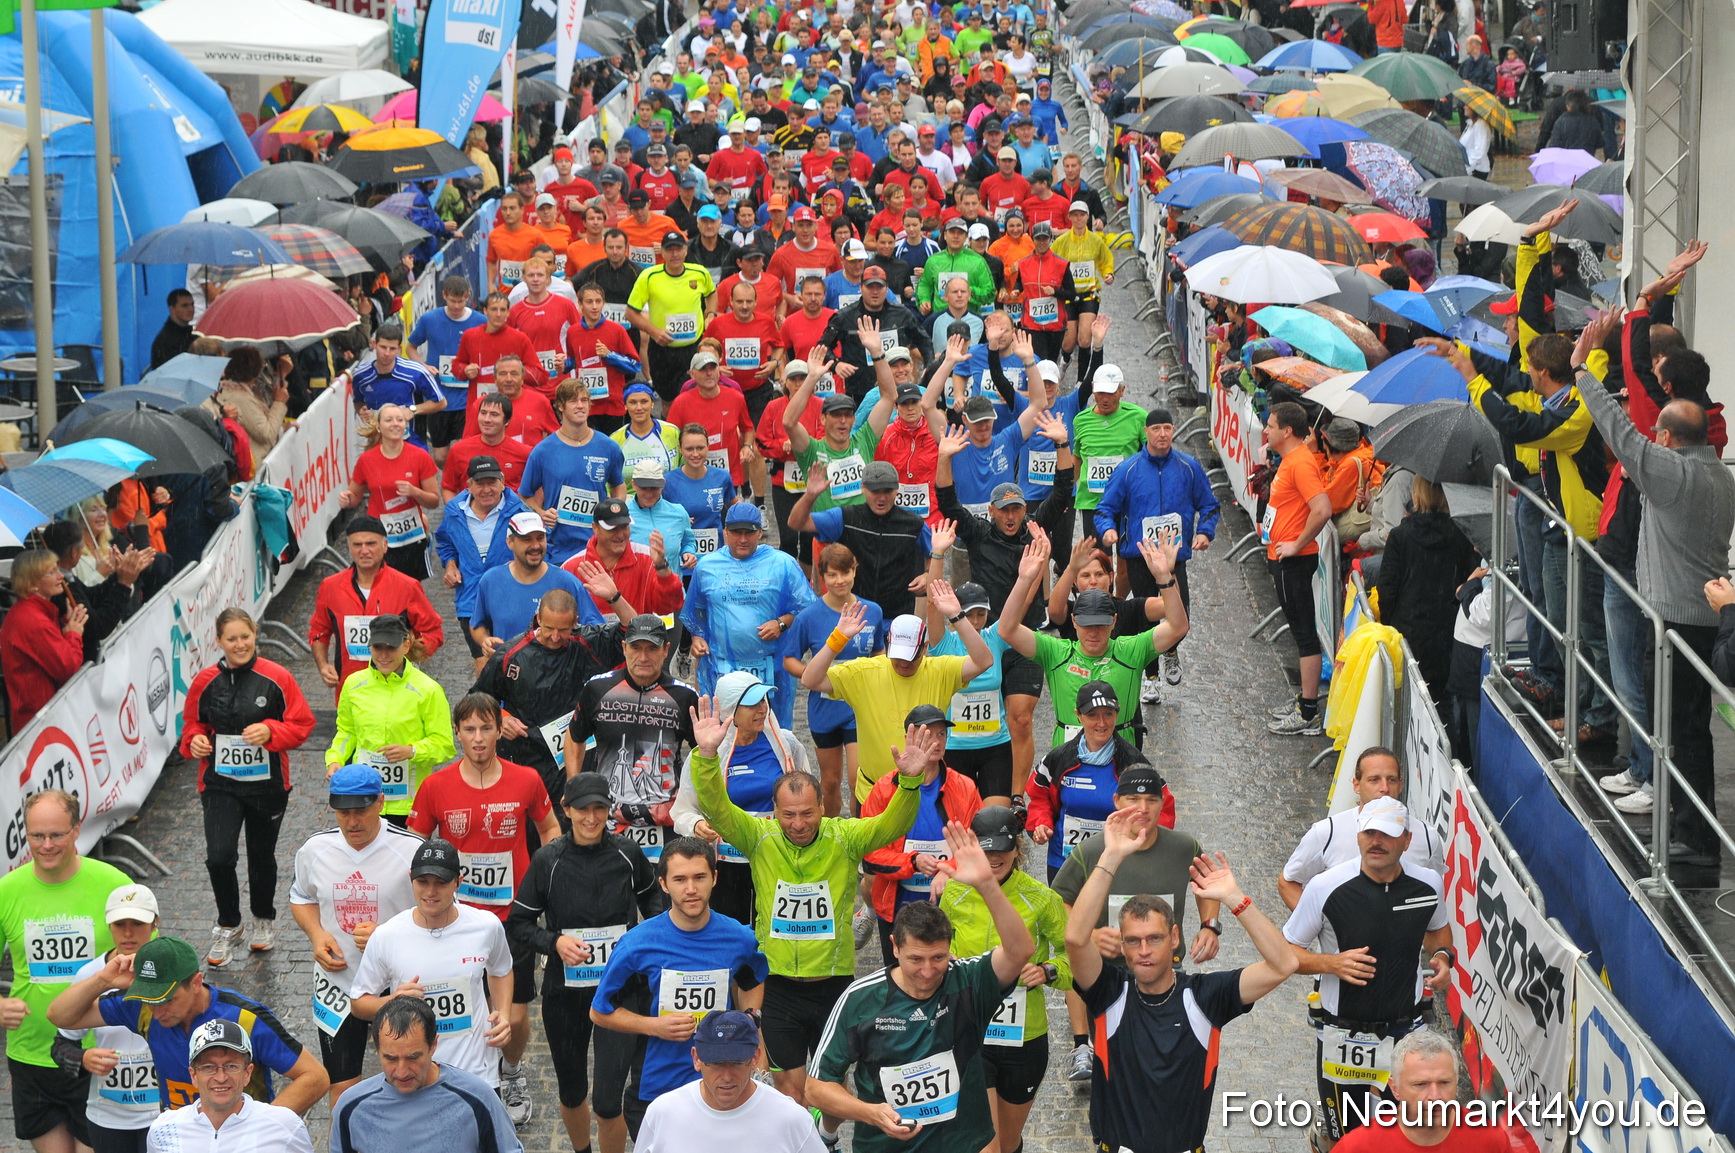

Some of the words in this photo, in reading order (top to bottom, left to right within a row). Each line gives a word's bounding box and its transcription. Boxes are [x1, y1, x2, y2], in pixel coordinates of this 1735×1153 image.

[477, 28, 494, 46] dsl
[204, 50, 323, 65] www.audibkk.de
[447, 75, 481, 143] axi-dsl.de
[631, 252, 653, 263] 2395
[1073, 267, 1089, 278] 425
[1032, 304, 1055, 315] 2782
[669, 320, 695, 333] 3289
[729, 346, 757, 358] 2355
[1032, 460, 1057, 473] 337
[834, 464, 864, 486] 2336
[563, 496, 598, 516] 2607
[896, 493, 926, 507] 3332
[387, 516, 419, 536] 2381
[569, 514, 585, 523] Peter
[600, 700, 679, 718] KLOSTERBIKER
[963, 703, 992, 721] 418
[596, 712, 680, 730] SELIGENPORTEN
[968, 724, 985, 732] Petra
[221, 747, 265, 766] 2664
[231, 767, 254, 776] Nicole
[96, 783, 123, 816] SEAT
[459, 865, 508, 886] 2507
[468, 887, 498, 898] Manuel
[777, 897, 829, 920] 2716
[786, 922, 817, 934] Johann
[32, 936, 89, 962] 3302
[48, 964, 74, 975] Klaus
[674, 987, 717, 1010] 550
[1336, 1043, 1376, 1068] 161
[1334, 1066, 1377, 1080] Wolfgang
[892, 1070, 953, 1106] 3257
[918, 1105, 940, 1118] Jörg
